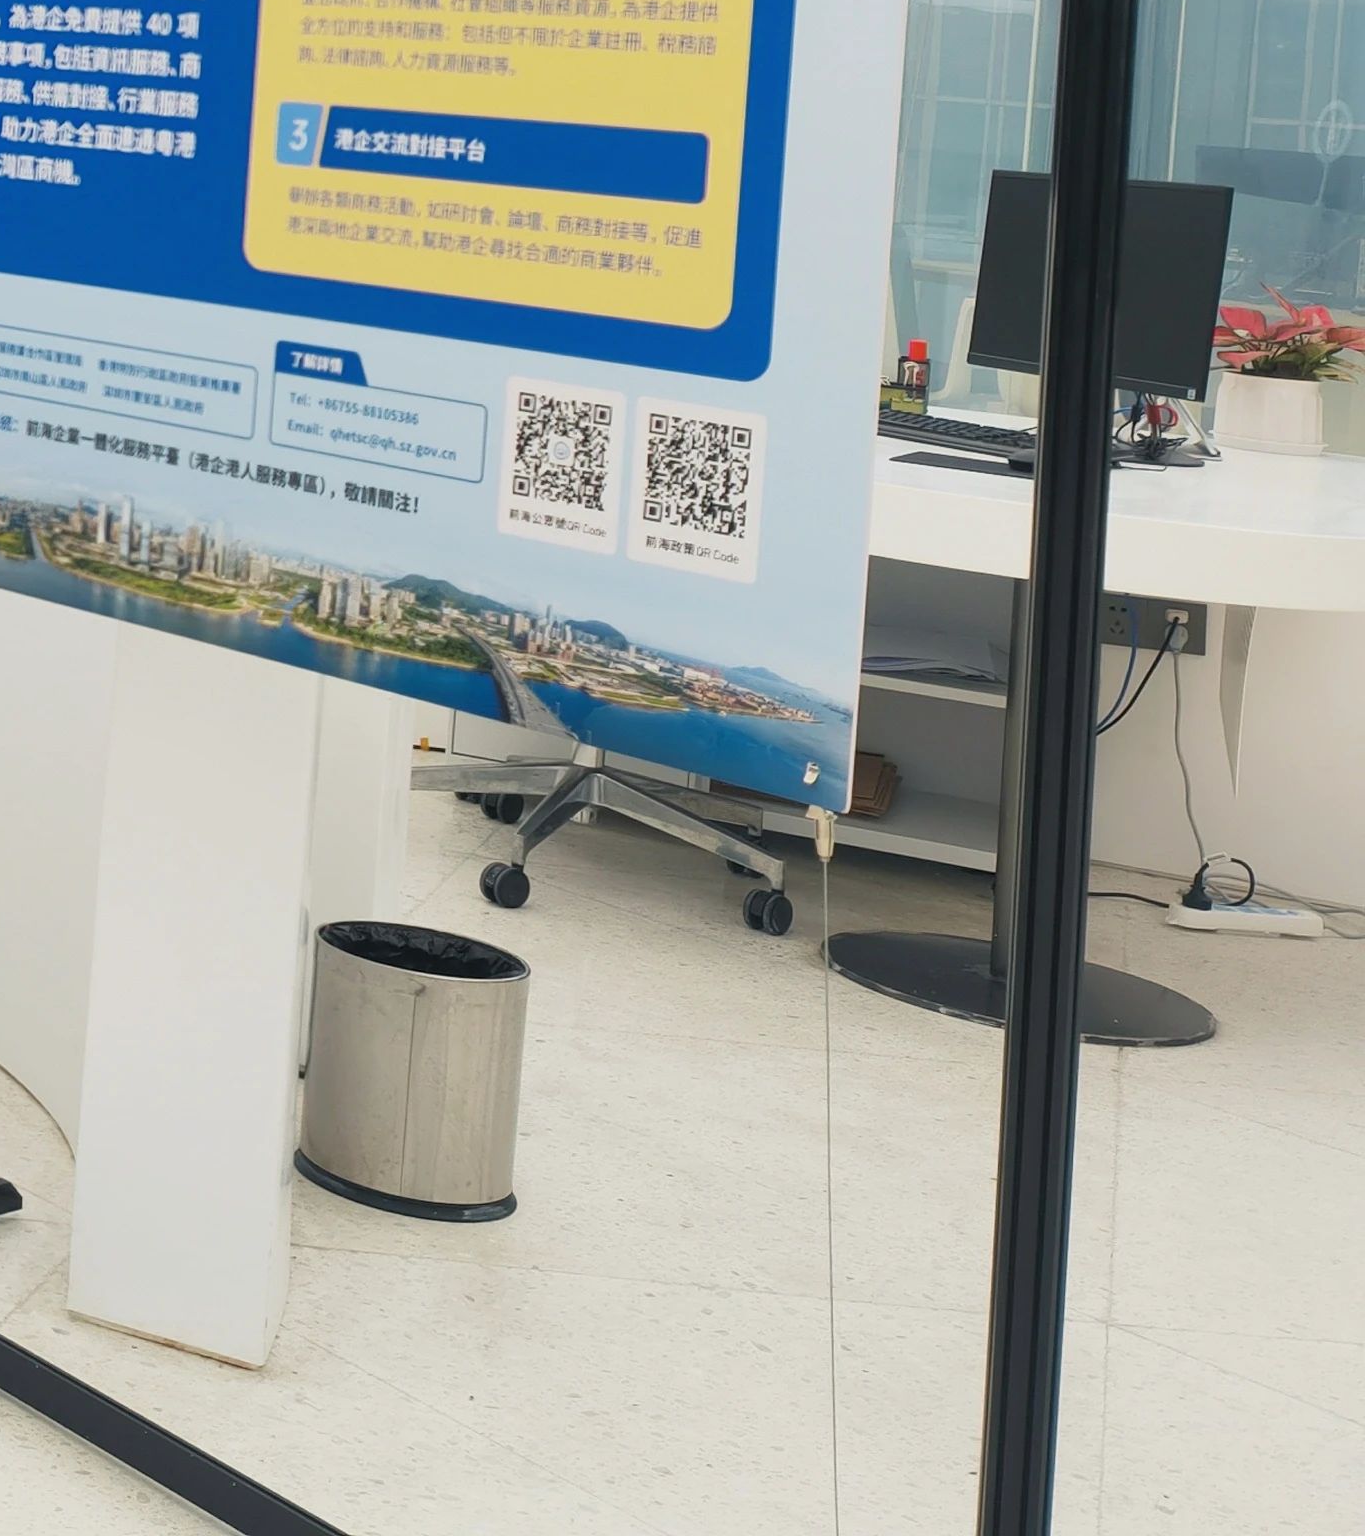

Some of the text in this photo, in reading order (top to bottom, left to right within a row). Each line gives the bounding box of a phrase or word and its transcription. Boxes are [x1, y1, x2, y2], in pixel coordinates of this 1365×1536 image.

[146, 12, 173, 36] 40
[288, 119, 309, 152] 3
[334, 128, 486, 163] 港企交流對接平台
